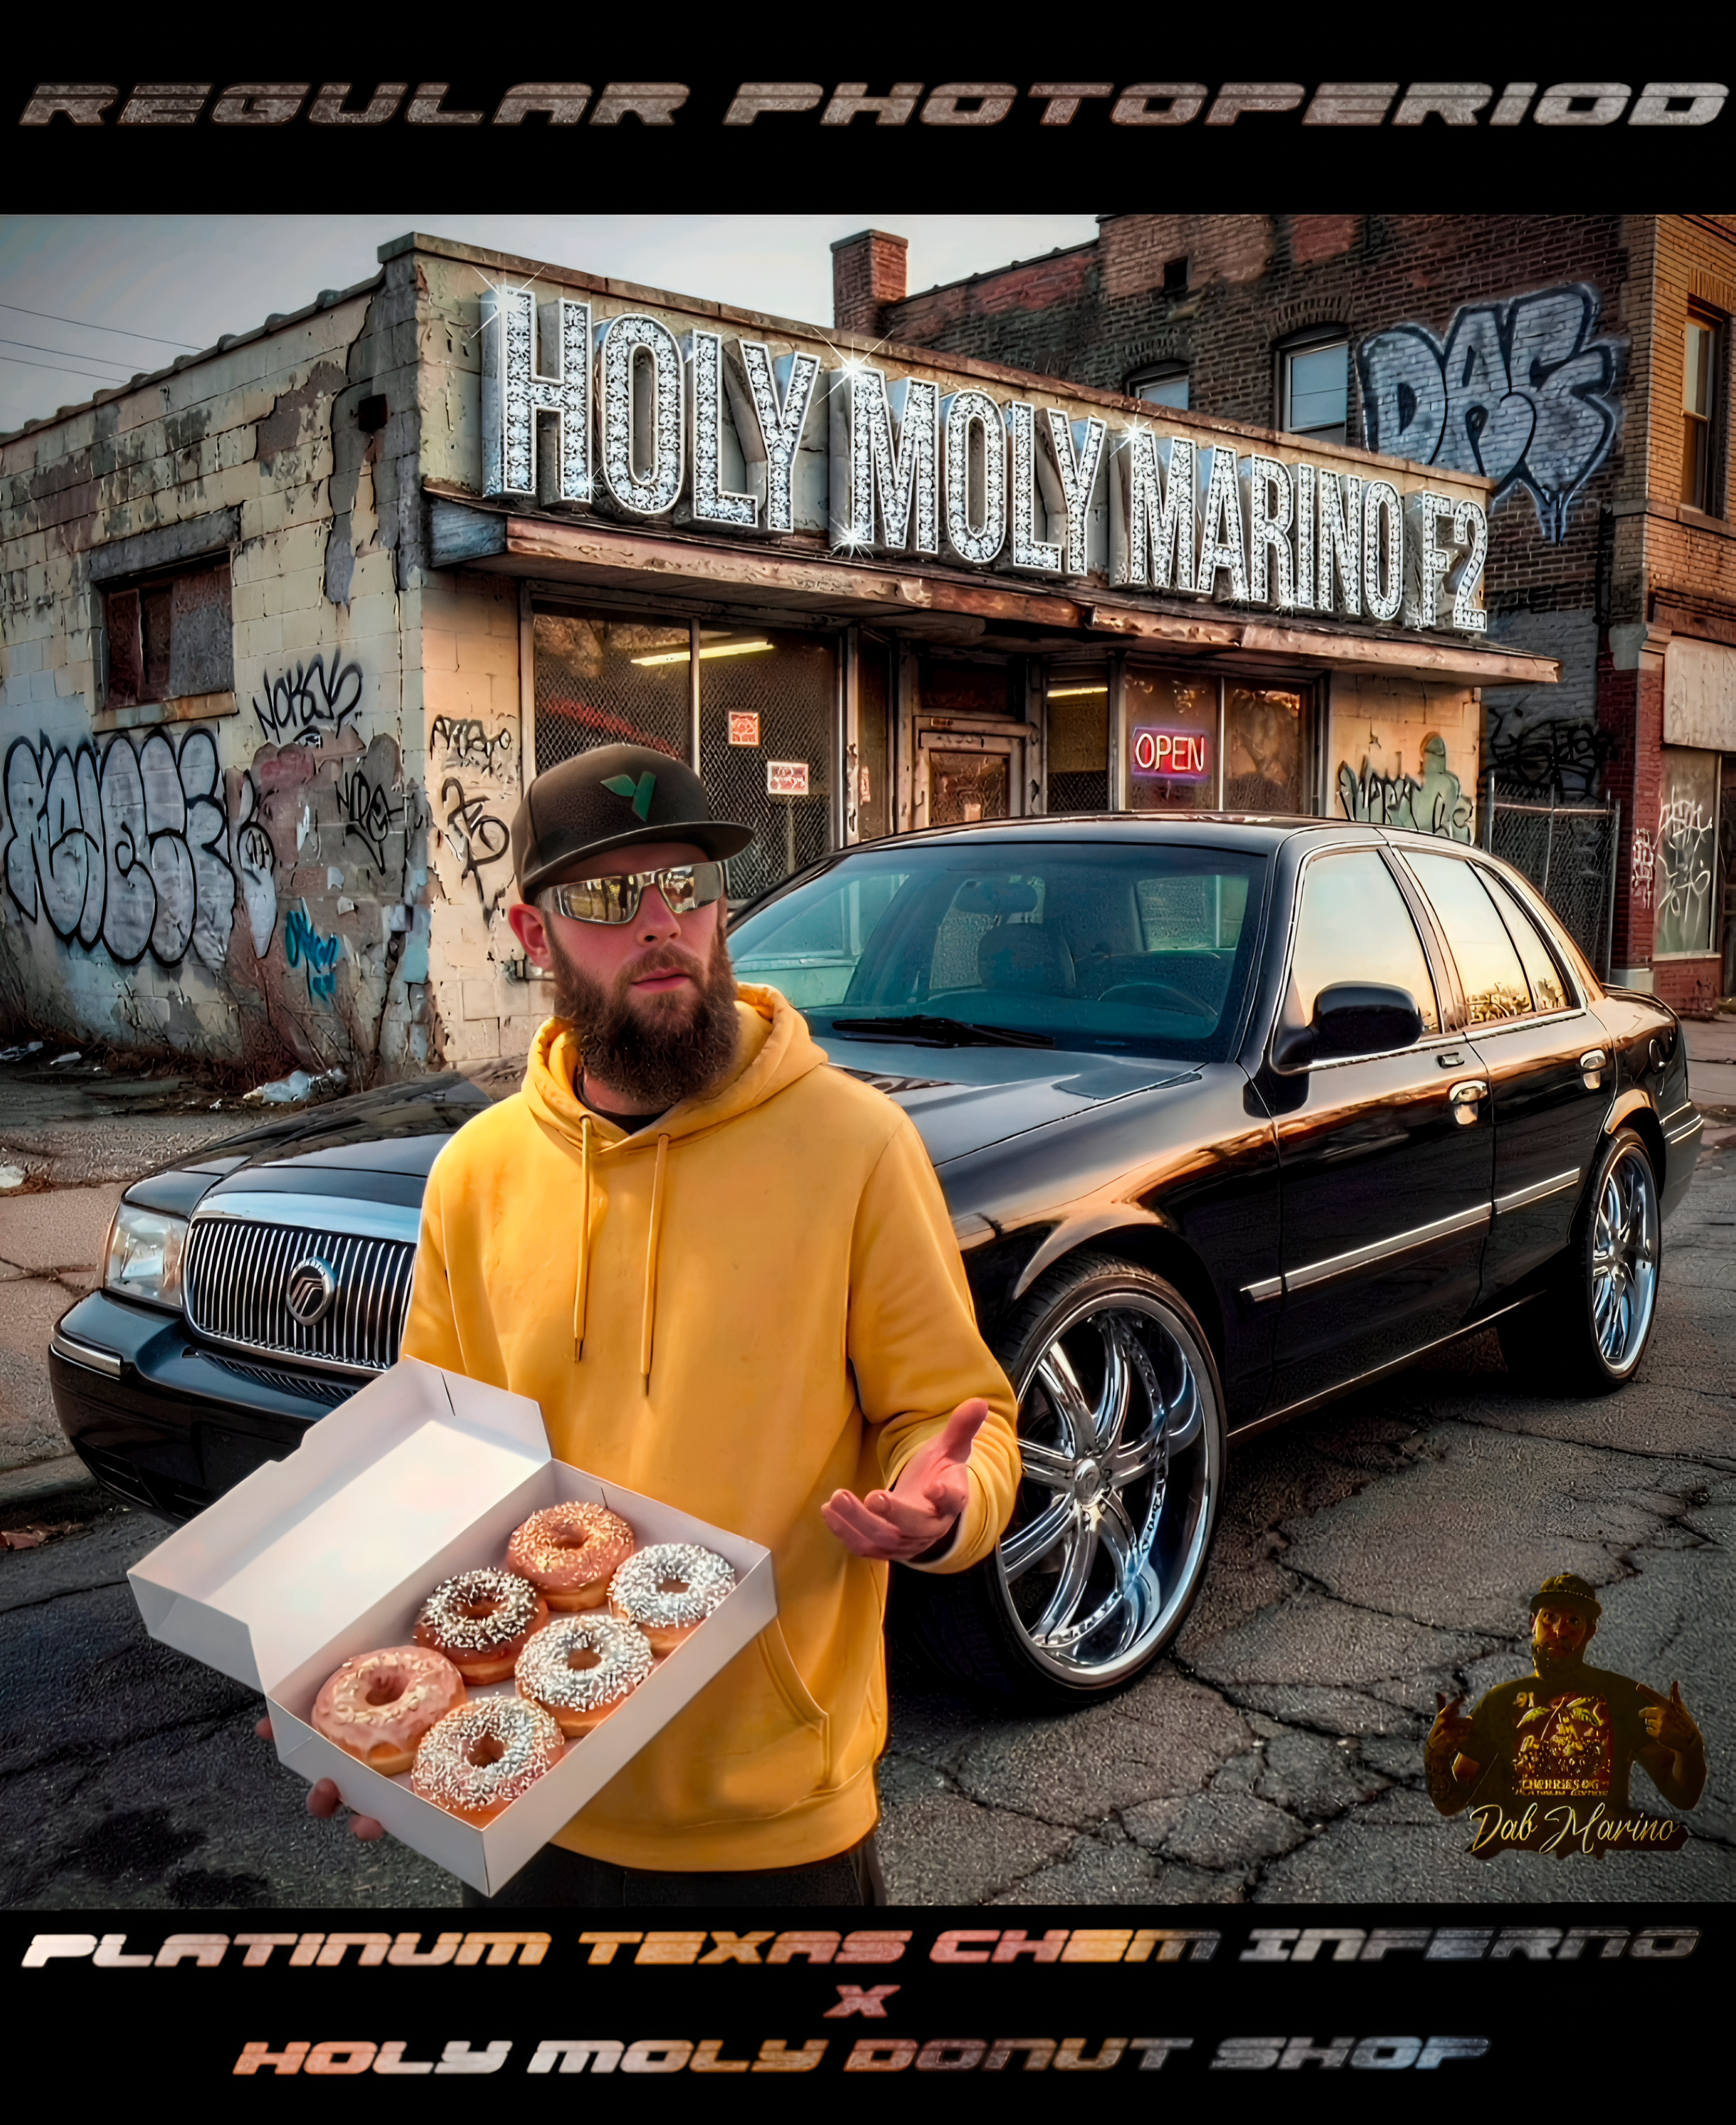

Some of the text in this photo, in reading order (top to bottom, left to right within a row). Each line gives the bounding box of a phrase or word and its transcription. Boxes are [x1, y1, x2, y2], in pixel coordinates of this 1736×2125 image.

[482, 285, 1488, 632] HOLY MOLY MARINO F2
[1135, 733, 1205, 771] OPEN
